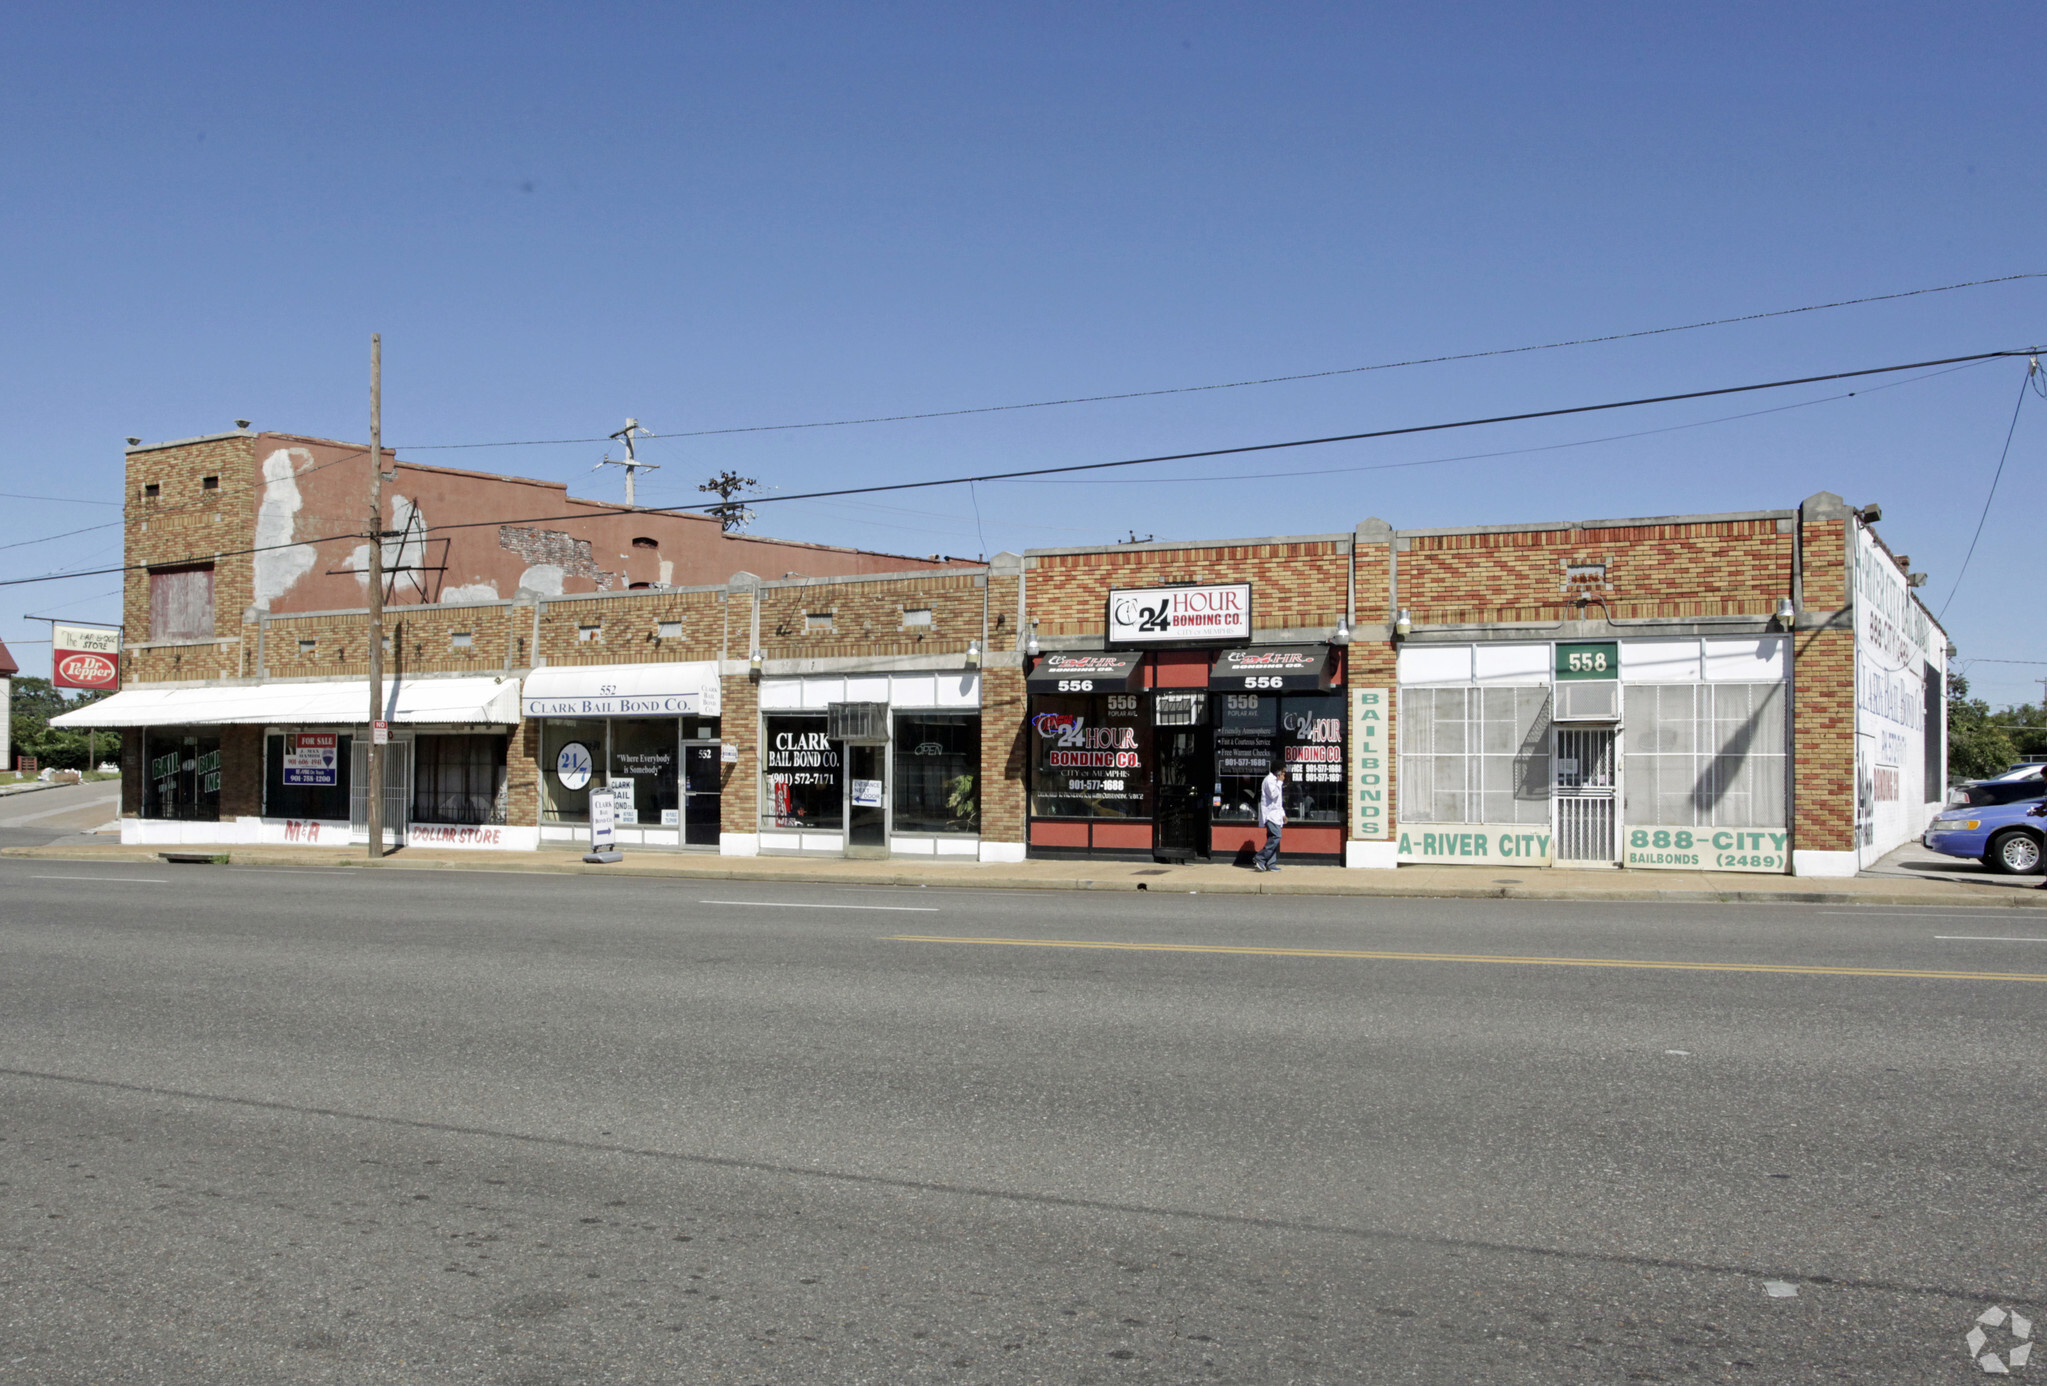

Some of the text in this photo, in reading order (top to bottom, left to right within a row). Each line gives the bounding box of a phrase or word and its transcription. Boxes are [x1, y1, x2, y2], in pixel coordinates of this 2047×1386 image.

[1173, 591, 1243, 612] HOUR
[1138, 599, 1170, 632] 24
[1172, 613, 1242, 627] BONDING CO.
[1204, 627, 1235, 635] MEMPHIS
[83, 641, 108, 650] STORE
[83, 658, 102, 669] Dr
[1569, 652, 1607, 672] 558
[67, 662, 111, 680] Pepper
[1058, 680, 1093, 692] 556
[1244, 676, 1283, 689] 556
[600, 685, 617, 696] 552
[530, 698, 691, 714] CLARK BAIL BOND CO.
[1108, 695, 1137, 710] 556
[1227, 694, 1258, 709] 556
[1057, 716, 1138, 749] 24 HOUR
[1297, 711, 1342, 743] 24 HOUR
[301, 736, 333, 745] FOR SALE
[776, 732, 831, 750] CLARK
[640, 754, 670, 763] Everybody
[698, 749, 711, 759] 552
[768, 751, 840, 767] BAIL BOND CO.
[1050, 750, 1141, 767] BONDING CO.
[1285, 746, 1343, 763] BONDING CO.
[152, 752, 180, 780] BAIL
[1224, 759, 1267, 767] 901-577-1688
[772, 772, 834, 786] (901) 572-7171
[1092, 770, 1130, 778] MEMPHIS
[1292, 773, 1303, 782] FAX
[611, 781, 631, 789] CLARK
[1068, 779, 1124, 791] 901-577-1688
[412, 826, 501, 845] DOLLAR STORE
[1630, 830, 1788, 851] 888-CITY
[1398, 832, 1550, 857] A-RIVER CITY
[1630, 852, 1784, 868] BAILBONDS (2489)
